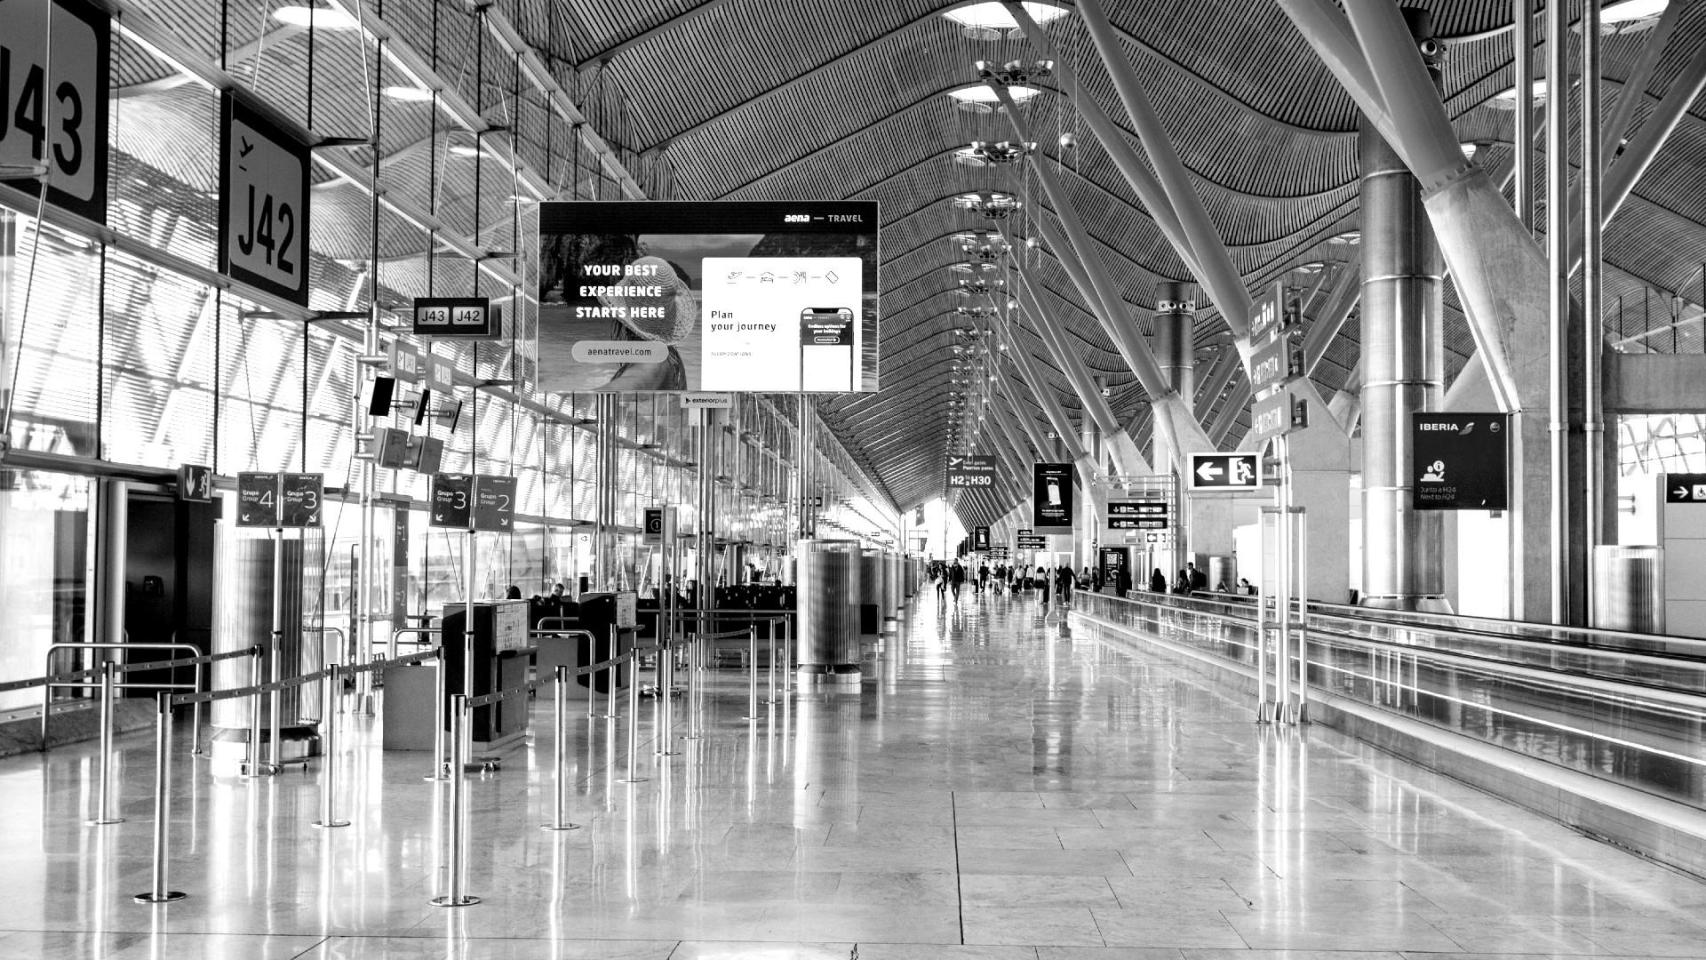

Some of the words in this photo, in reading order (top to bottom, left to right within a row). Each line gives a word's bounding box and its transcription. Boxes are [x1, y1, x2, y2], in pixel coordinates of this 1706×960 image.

[784, 214, 811, 223] aena
[828, 214, 863, 223] TRAVEL
[238, 184, 294, 275] J42
[584, 265, 621, 276] YOUR
[625, 265, 659, 276] BEST
[580, 286, 662, 297] EXPERIENCE
[422, 311, 445, 322] J43
[457, 311, 480, 322] J42
[576, 307, 627, 318] STARTS
[630, 307, 666, 318] HERE
[711, 310, 733, 319] Plan
[711, 323, 734, 332] your
[738, 321, 777, 332] journey
[587, 347, 652, 356] aenatravel.com
[1420, 423, 1459, 431] IBERIA
[951, 475, 965, 485] H2
[971, 475, 991, 486] H30
[259, 490, 274, 508] 4
[304, 490, 317, 509] 3
[453, 491, 466, 510] 3
[497, 494, 510, 512] 2
